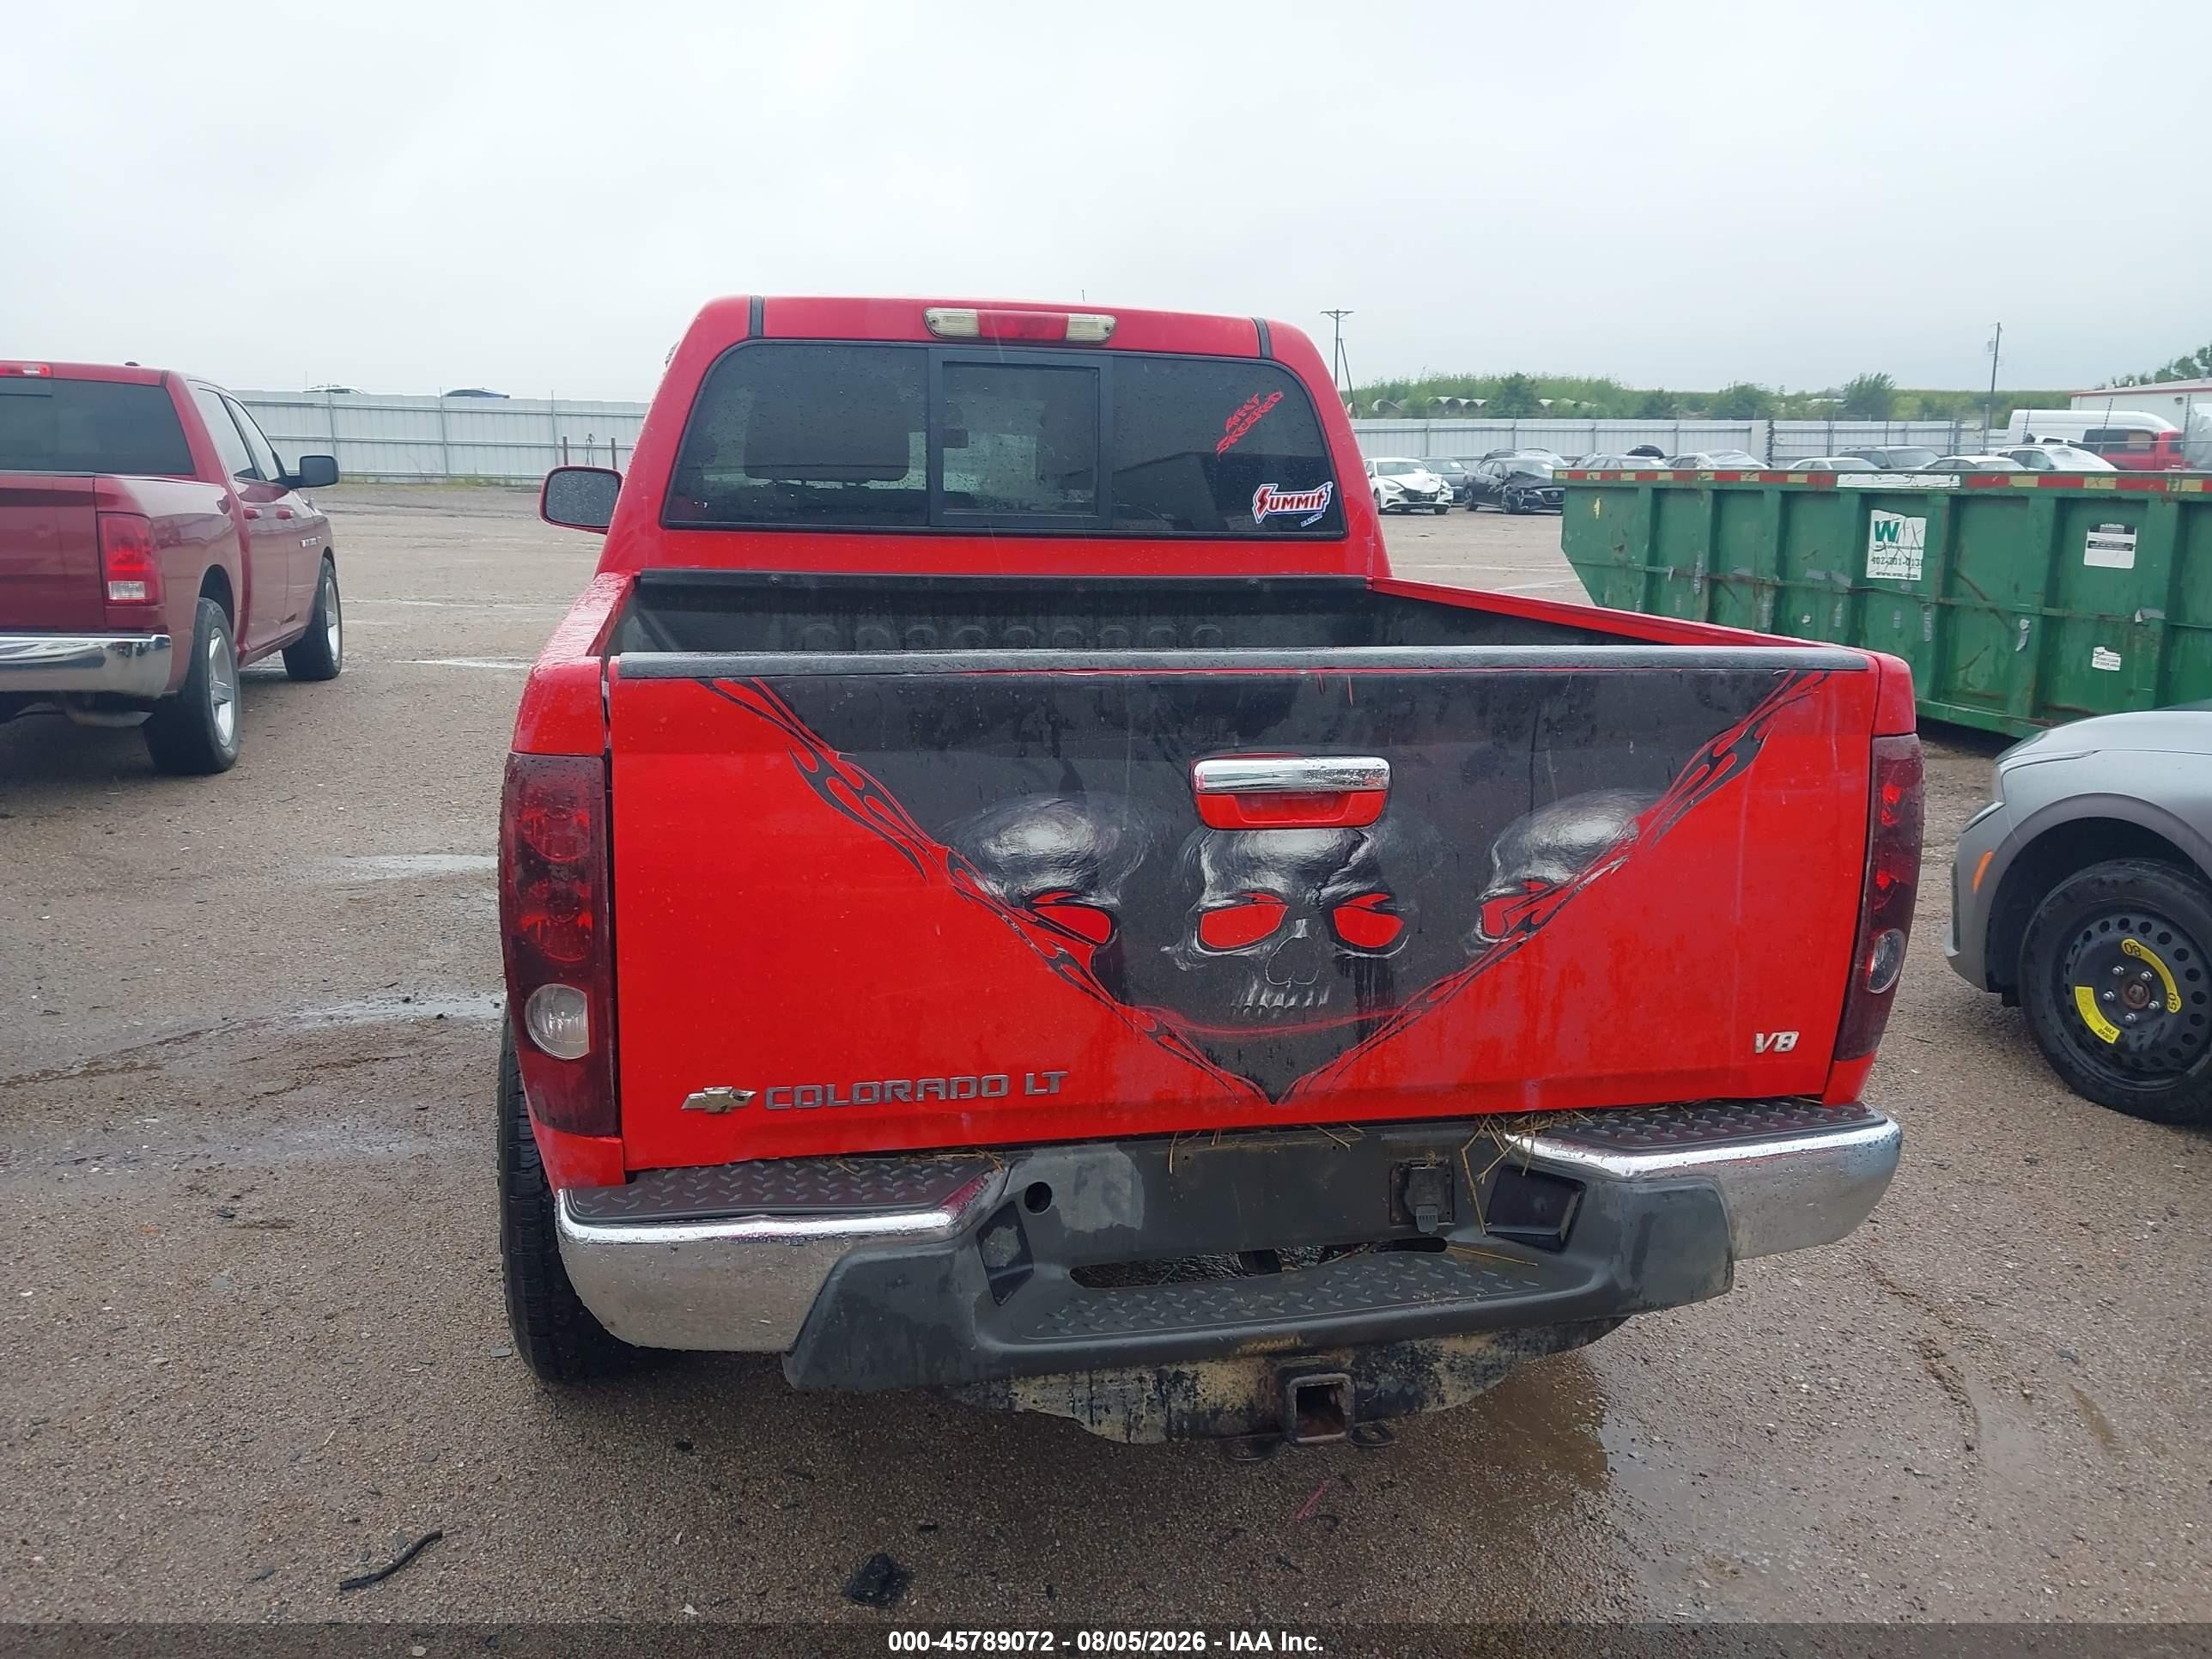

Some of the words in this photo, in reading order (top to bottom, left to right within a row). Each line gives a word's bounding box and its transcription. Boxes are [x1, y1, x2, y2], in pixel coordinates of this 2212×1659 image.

[1754, 1030, 1800, 1054] V8
[764, 1074, 1010, 1110] COLORADO
[1024, 1071, 1068, 1096] LT
